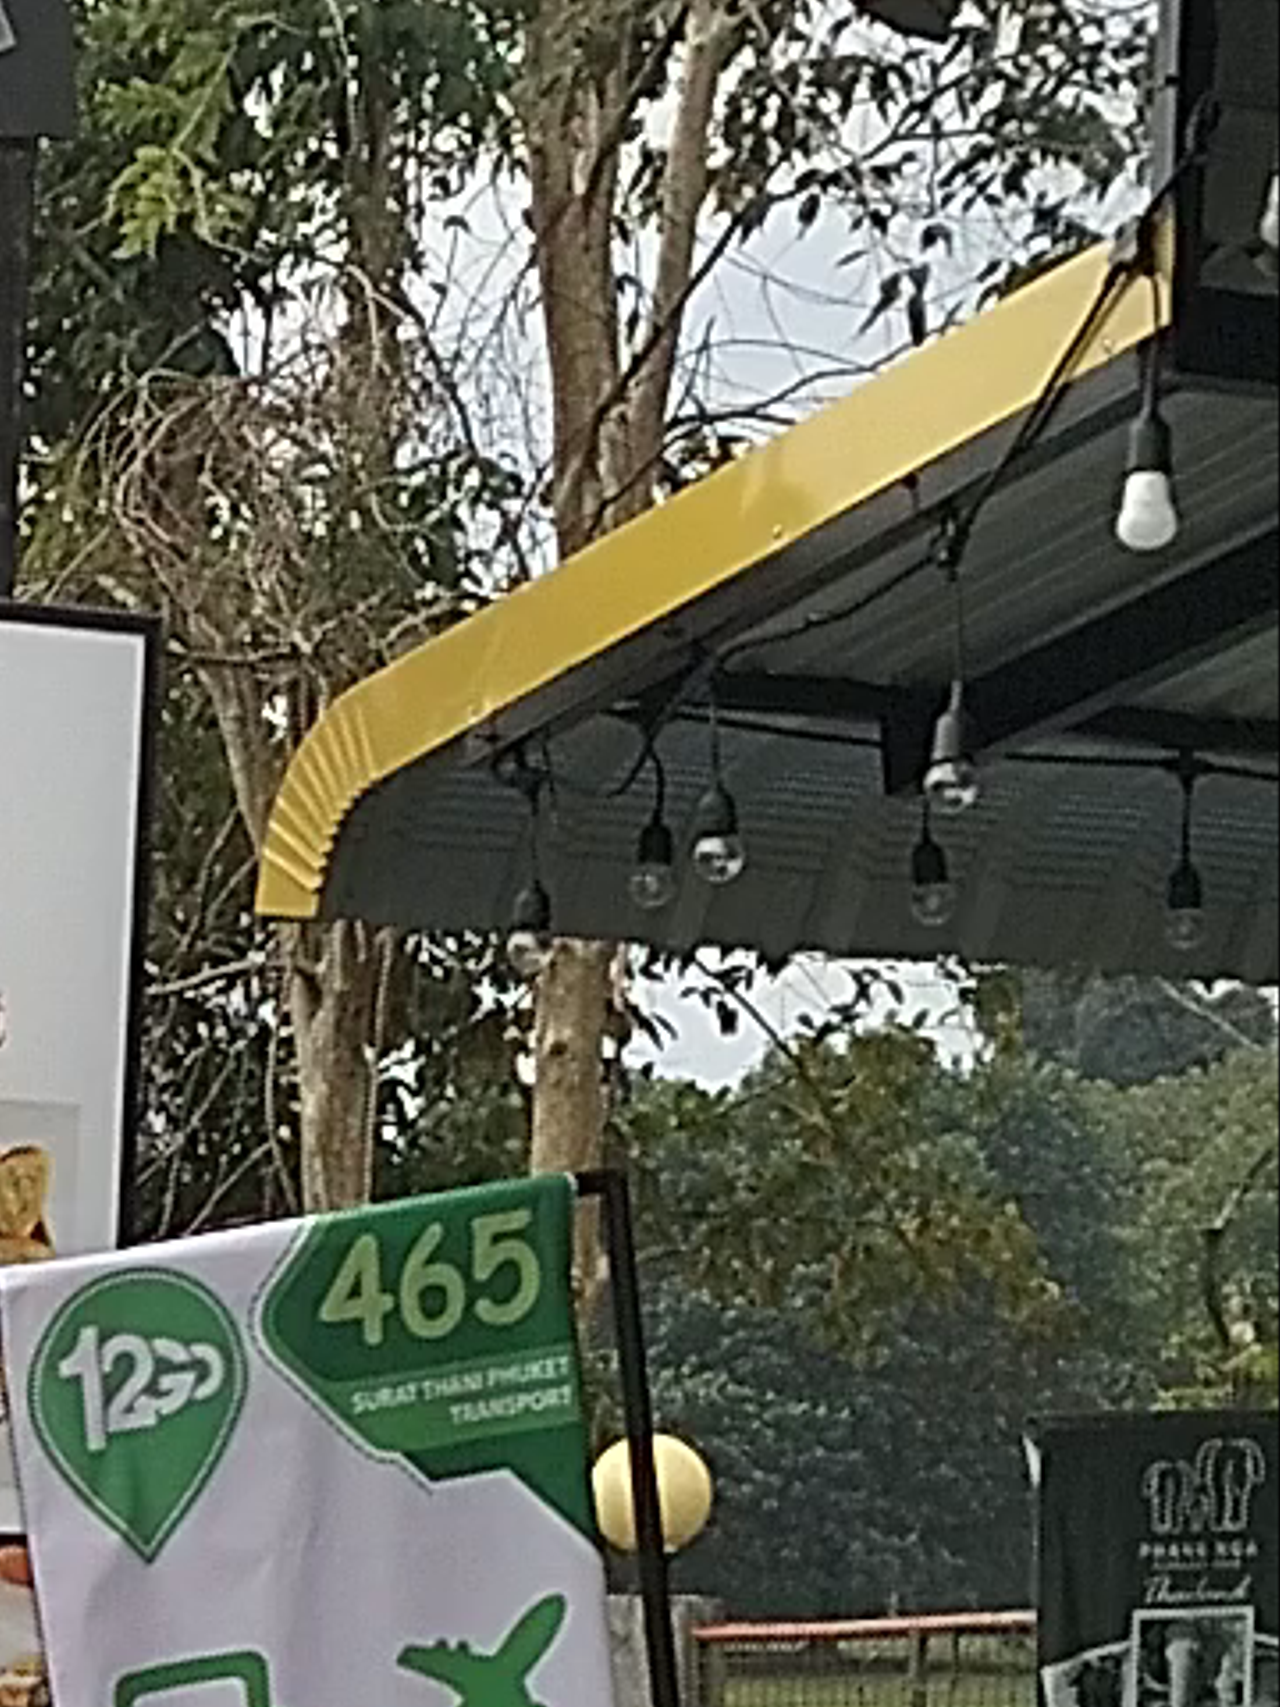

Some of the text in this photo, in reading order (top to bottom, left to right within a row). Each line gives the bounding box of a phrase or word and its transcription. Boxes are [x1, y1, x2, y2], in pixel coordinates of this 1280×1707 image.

[318, 1207, 541, 1347] 465
[352, 1356, 570, 1415] SURAT THANI PHUKET
[449, 1385, 572, 1425] TRANSPORT
